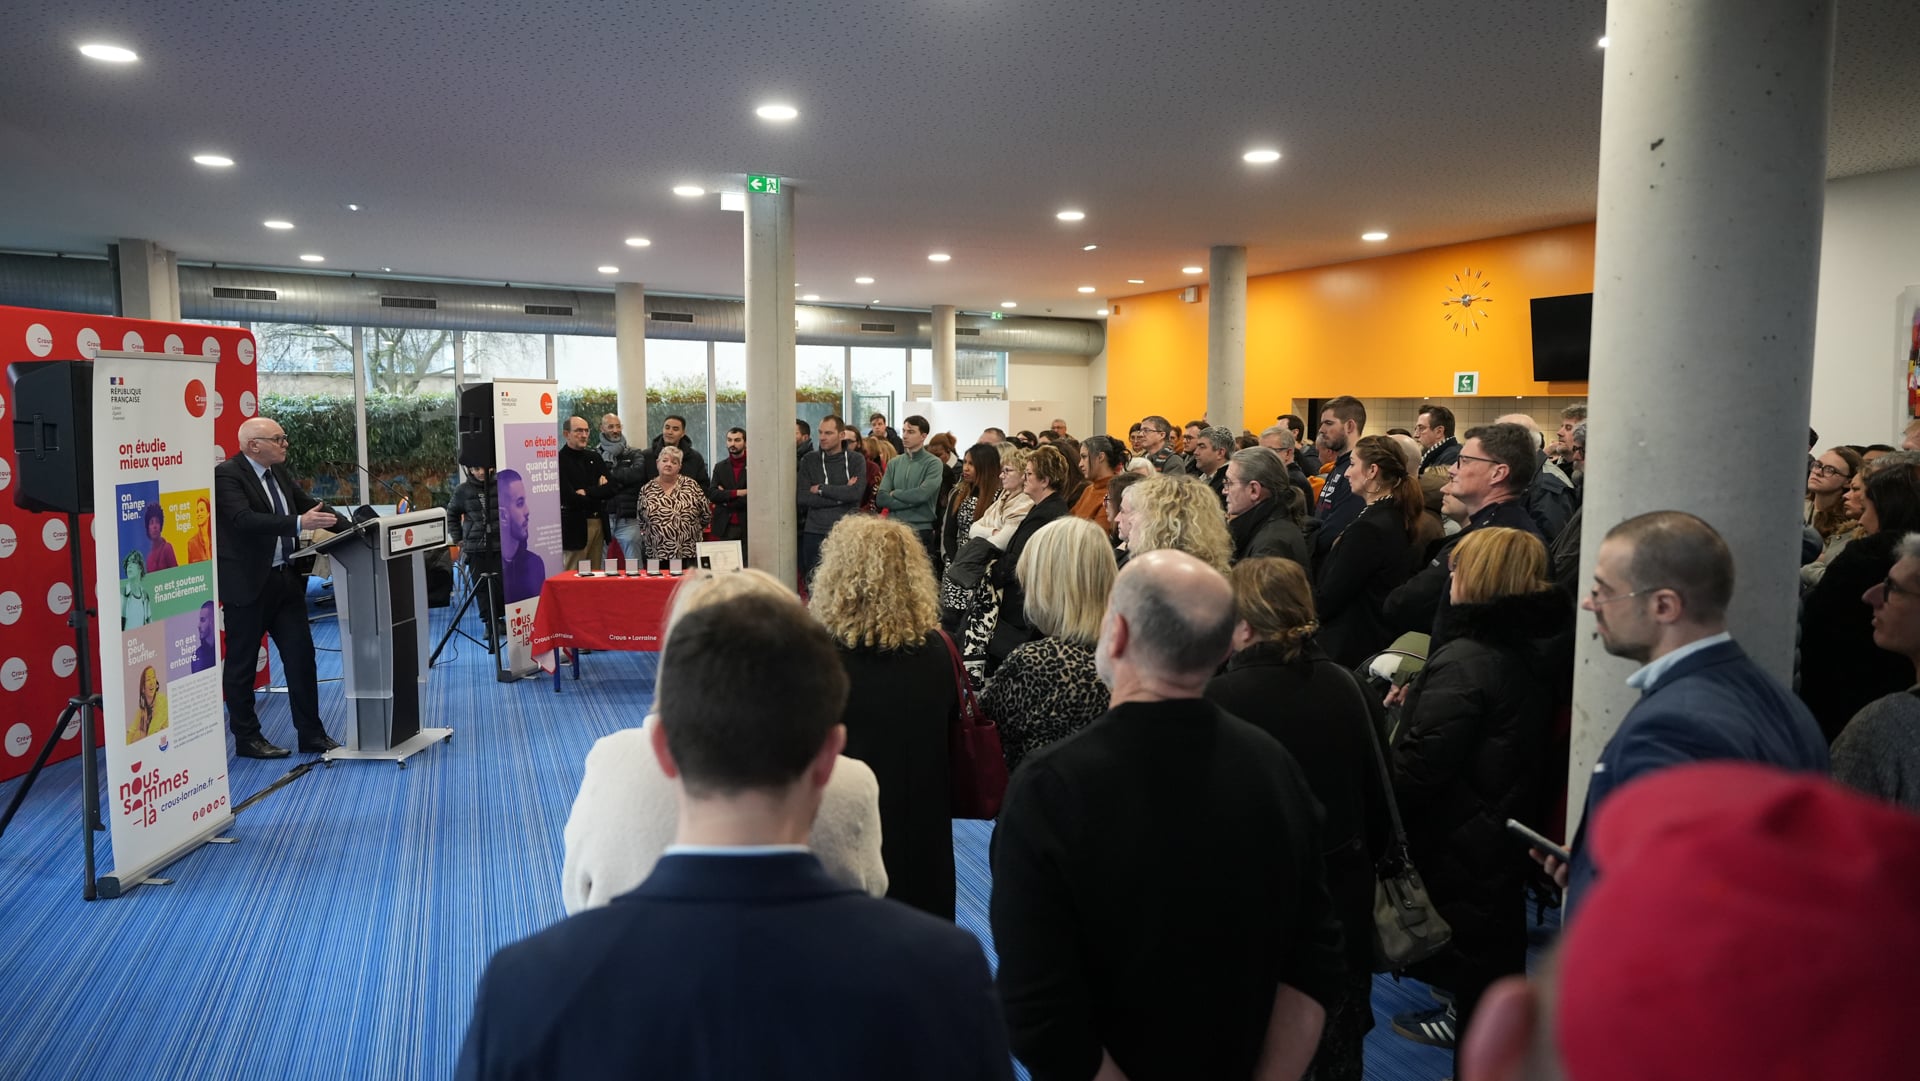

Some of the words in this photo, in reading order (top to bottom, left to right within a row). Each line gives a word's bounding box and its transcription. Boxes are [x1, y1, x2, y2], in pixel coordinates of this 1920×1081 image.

[119, 444, 132, 454] on
[136, 438, 166, 454] étudie
[525, 440, 534, 448] on
[535, 436, 556, 446] étudie
[120, 455, 150, 470] mieux
[152, 450, 182, 470] quand
[526, 459, 548, 474] quand
[550, 460, 558, 469] on
[532, 472, 542, 482] est
[122, 494, 131, 502] on
[122, 500, 145, 510] mange
[169, 504, 178, 512] on
[179, 502, 190, 510] est
[122, 510, 141, 520] bien.
[175, 511, 190, 521] bien
[154, 584, 164, 593] on
[164, 581, 175, 590] est
[176, 575, 204, 588] soutenu
[154, 583, 208, 604] financièrement.
[128, 638, 138, 646] on
[175, 639, 184, 648] on
[185, 634, 196, 644] est
[128, 642, 144, 658] peut
[181, 644, 196, 656] bien
[128, 650, 158, 666] souffler.
[170, 654, 200, 670] entouré.
[120, 768, 160, 800] nous
[124, 769, 189, 815] sommes
[160, 776, 214, 812] crous-lorraine.fr
